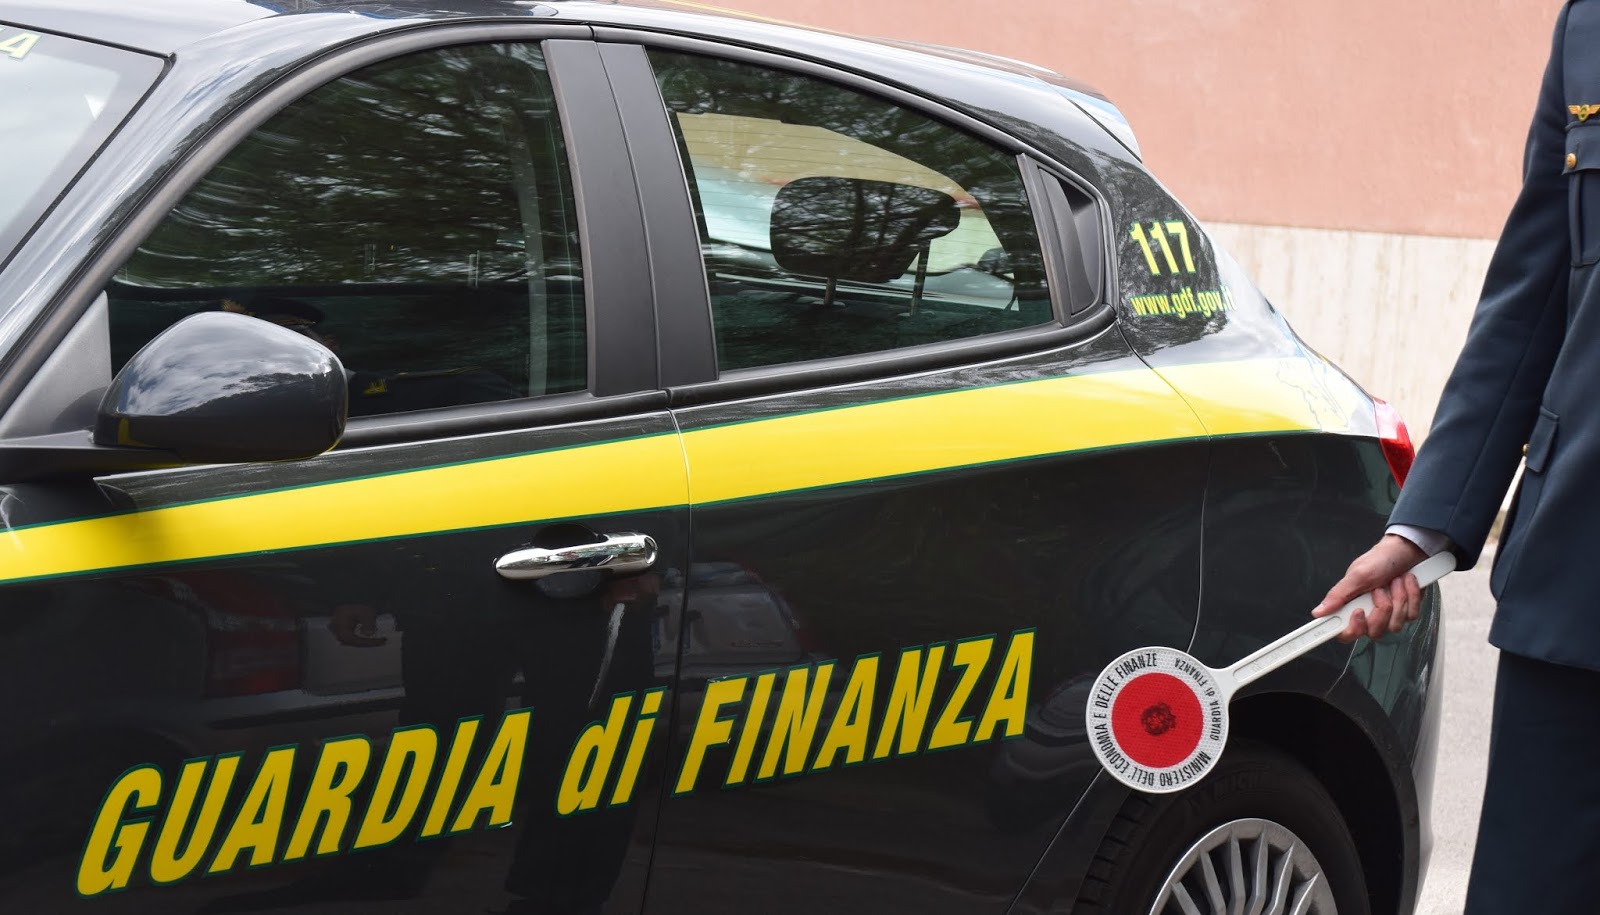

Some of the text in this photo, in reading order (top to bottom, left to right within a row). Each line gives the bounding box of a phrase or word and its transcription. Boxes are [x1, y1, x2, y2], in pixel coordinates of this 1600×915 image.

[1129, 221, 1196, 275] 117
[1130, 285, 1237, 318] www.gdf.gov.it
[1115, 653, 1157, 679] FINANZE
[1095, 675, 1119, 709] DELLE
[1174, 658, 1222, 741] GUARDIA di FINANZA
[76, 628, 1037, 896] GUARDIA di FINANZA
[1160, 751, 1212, 786] MINISTERO
